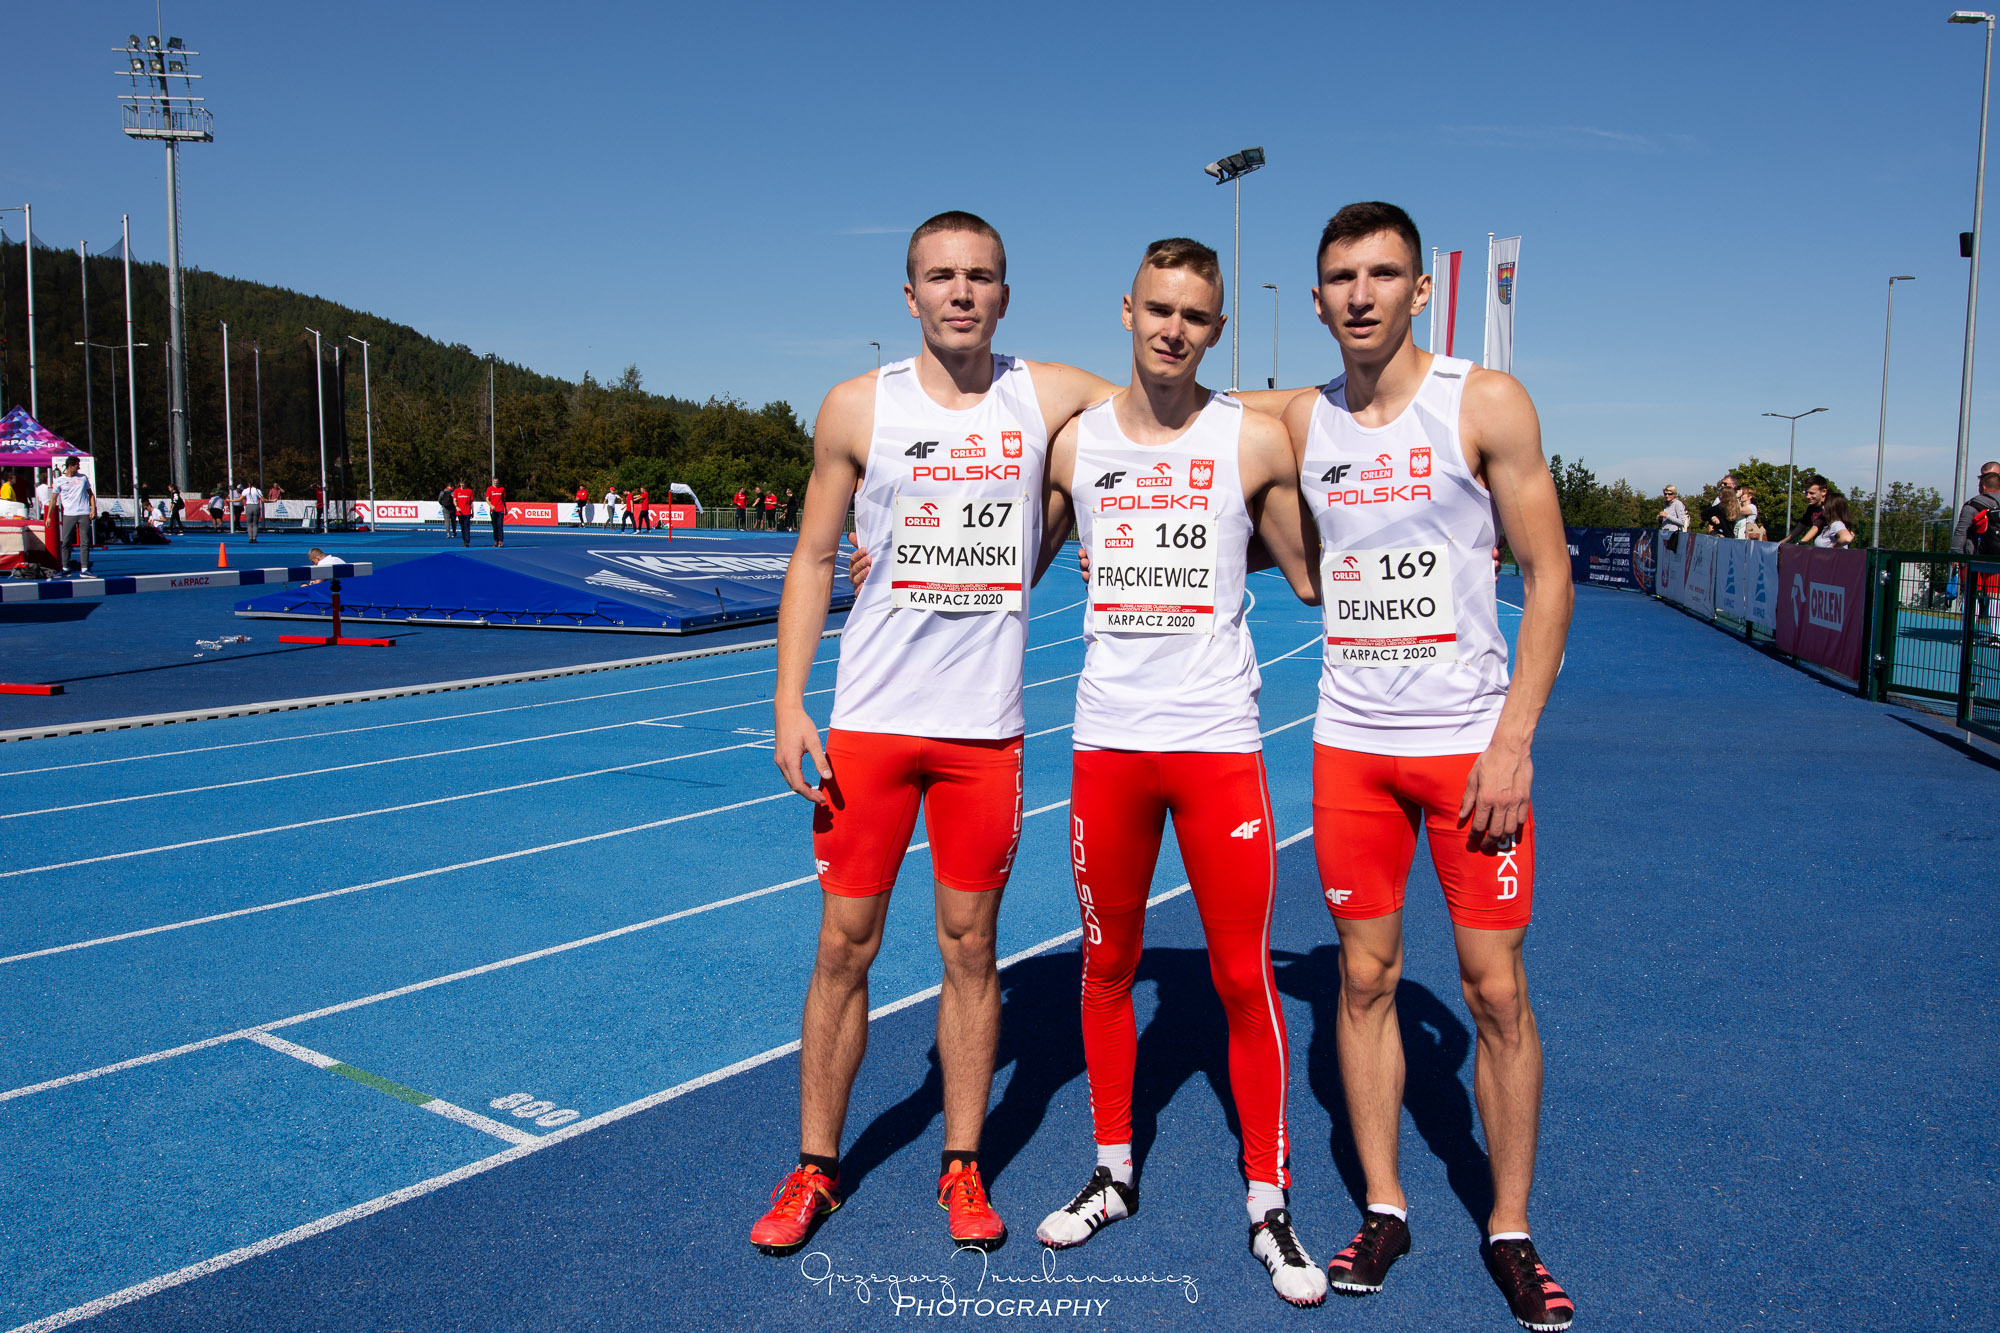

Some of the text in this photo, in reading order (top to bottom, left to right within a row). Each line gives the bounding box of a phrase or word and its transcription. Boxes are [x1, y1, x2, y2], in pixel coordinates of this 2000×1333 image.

[904, 441, 939, 459] 4F
[952, 449, 984, 458] ORLEN
[913, 464, 1020, 481] POLSKA
[1094, 471, 1127, 489] 4F
[1321, 464, 1352, 484] 4F
[1361, 468, 1392, 480] ORLEN
[1138, 478, 1171, 487] ORLEN
[1101, 494, 1208, 512] POLSKA
[1327, 484, 1431, 507] POLSKA
[378, 506, 417, 517] ORLEN
[526, 509, 550, 518] ORLEN
[962, 502, 1013, 528] 167
[906, 518, 938, 527] ORLEN
[1106, 539, 1133, 548] ORLEN
[1155, 523, 1207, 550] 168
[896, 542, 1016, 567] SZYMAŃSKI
[1378, 550, 1437, 581] 169
[1097, 566, 1210, 591] FRĄCKIEWICZ
[1333, 571, 1360, 581] ORLEN
[910, 591, 1003, 606] KARPACZ 2020
[1810, 588, 1843, 624] ORLEN
[1337, 596, 1436, 621] DEJNEKO
[1108, 614, 1195, 628] KARPACZ 2020
[1342, 645, 1437, 661] KARPACZ 2020
[1230, 818, 1262, 840] 4F
[1072, 814, 1102, 946] POLSKA
[1325, 887, 1353, 905] 4F
